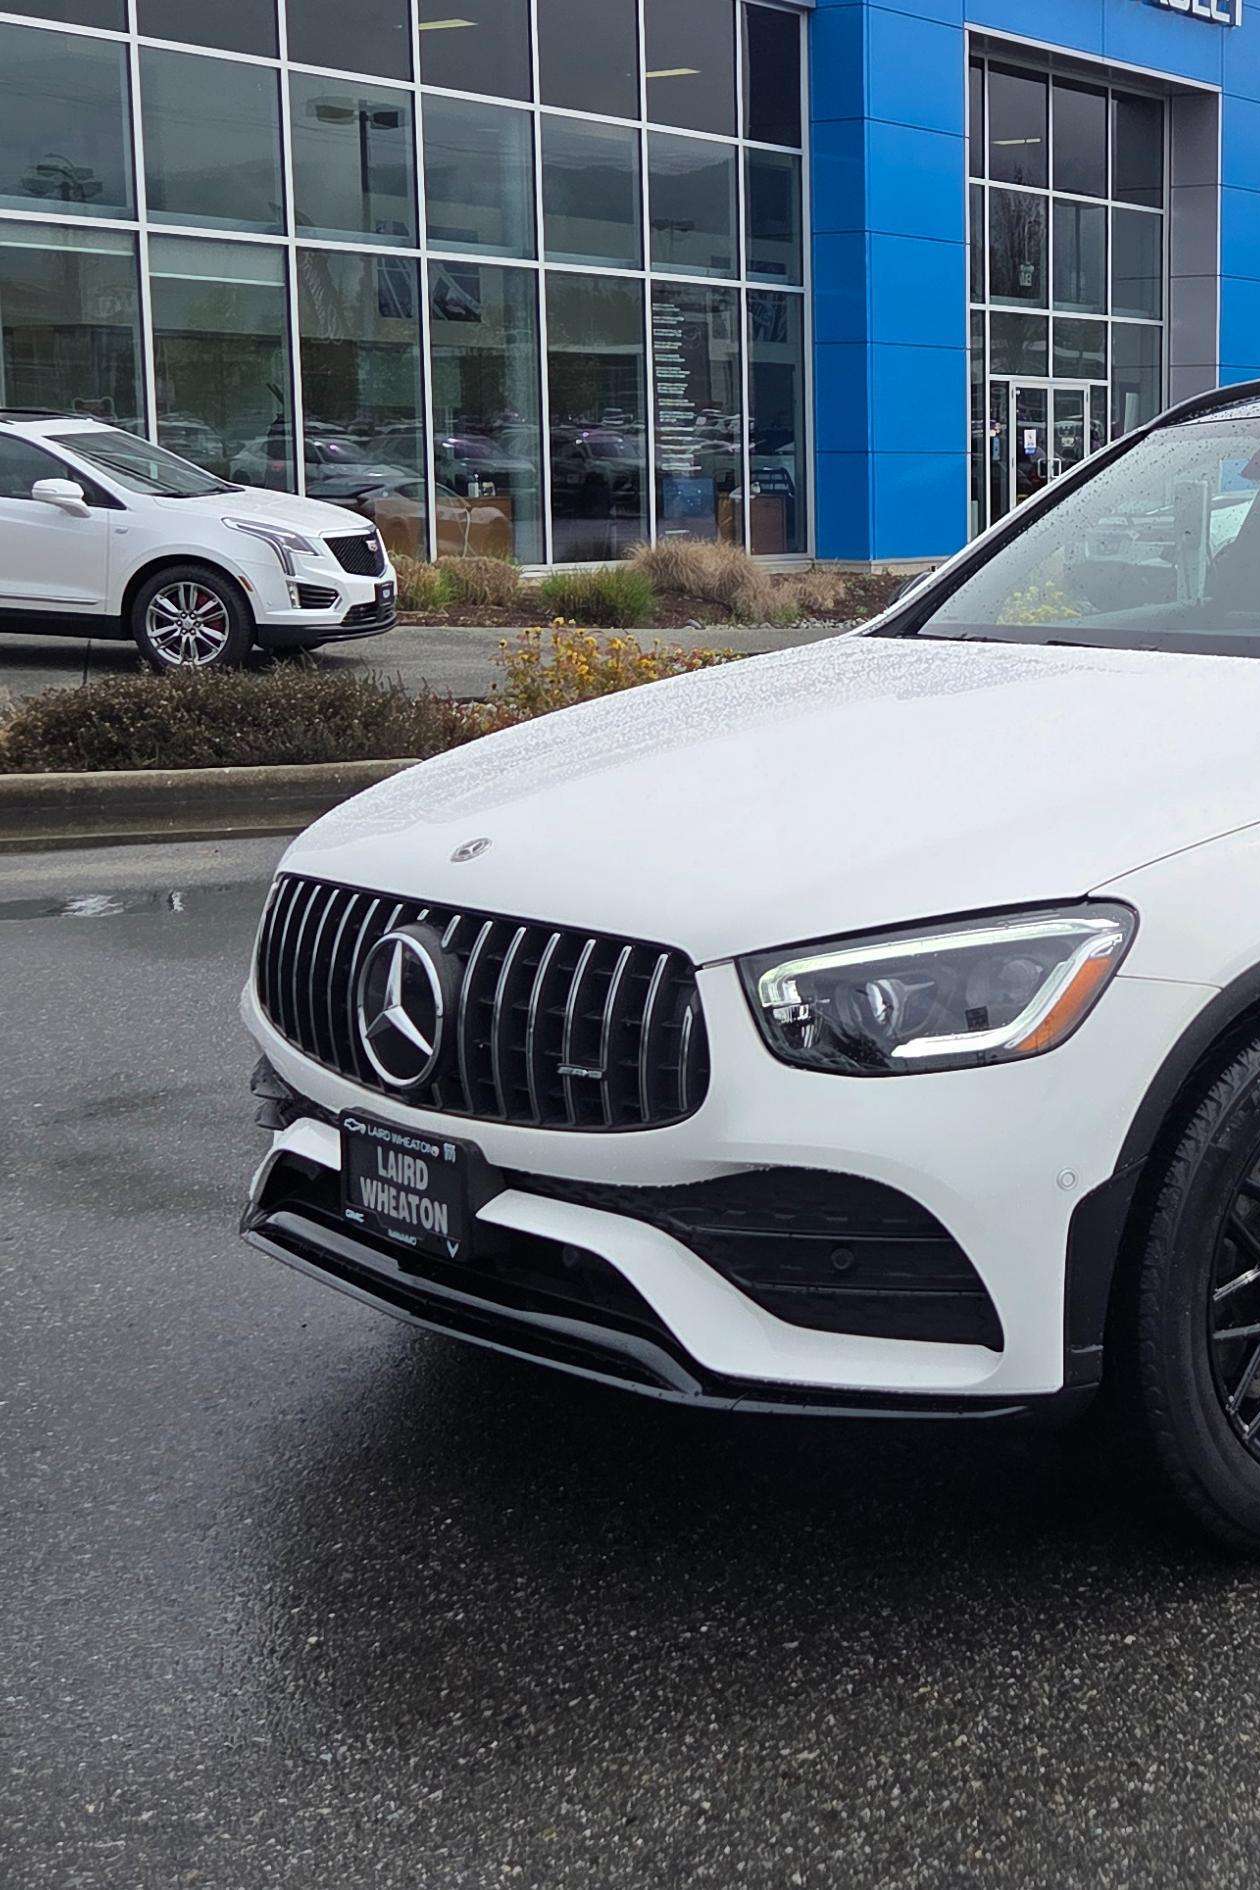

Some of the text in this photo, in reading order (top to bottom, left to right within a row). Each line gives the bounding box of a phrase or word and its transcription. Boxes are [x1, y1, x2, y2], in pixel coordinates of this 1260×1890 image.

[367, 1124, 391, 1141] LAIRD
[377, 1146, 429, 1190] LAIRD
[360, 1176, 448, 1235] WHEATON
